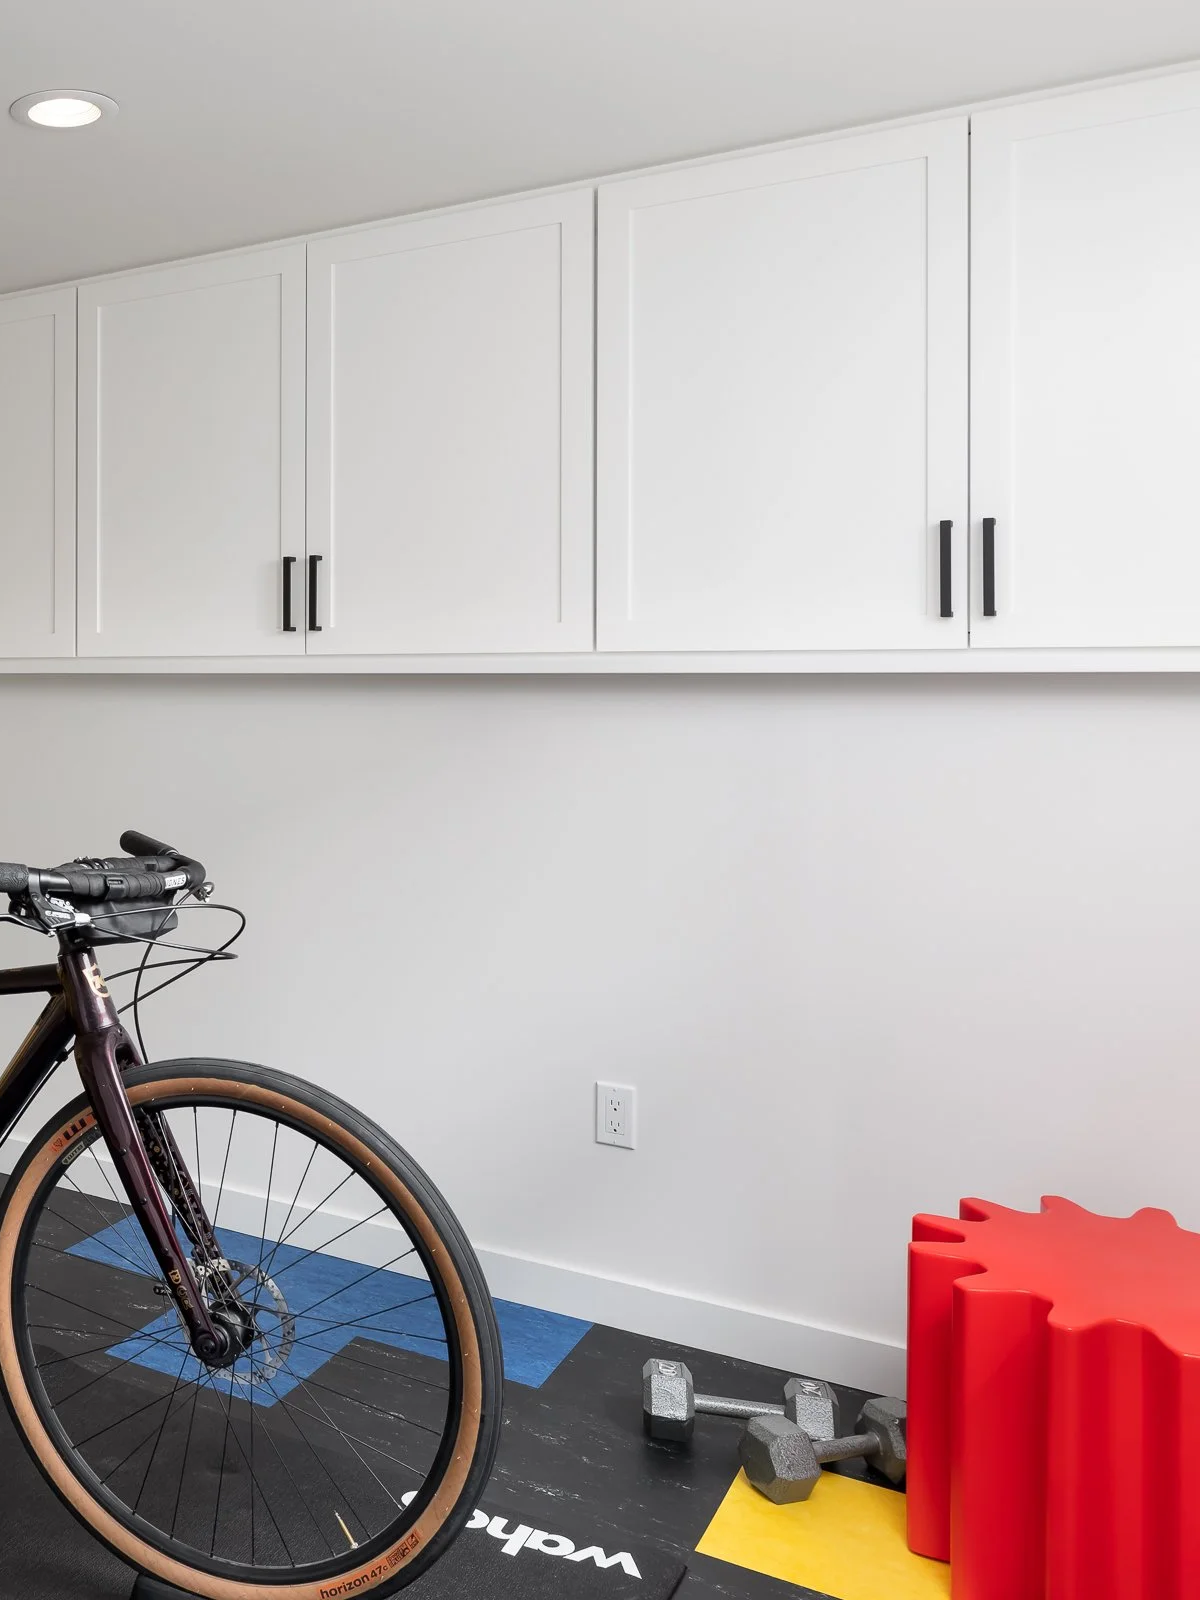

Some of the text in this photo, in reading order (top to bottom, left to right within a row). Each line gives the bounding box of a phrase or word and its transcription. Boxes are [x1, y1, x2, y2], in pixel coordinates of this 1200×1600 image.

[400, 1490, 643, 1580] wah
[320, 1565, 389, 1599] horizon 47c
